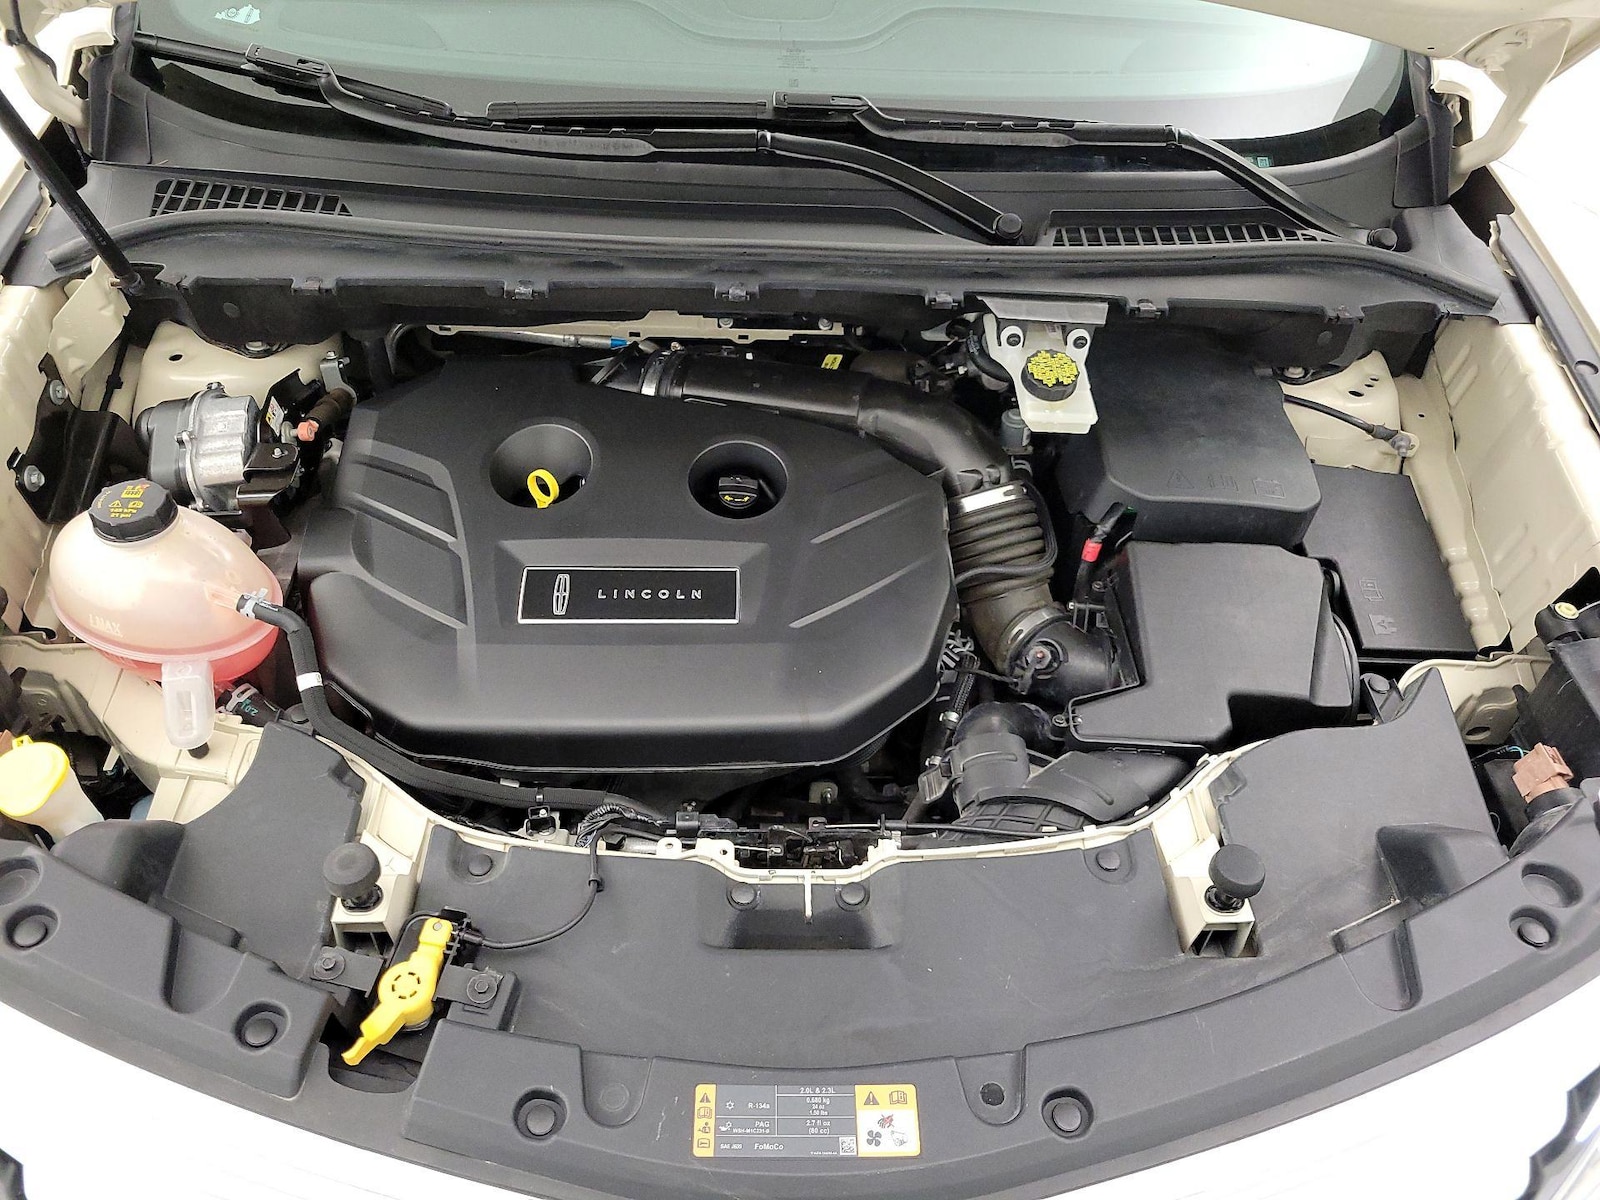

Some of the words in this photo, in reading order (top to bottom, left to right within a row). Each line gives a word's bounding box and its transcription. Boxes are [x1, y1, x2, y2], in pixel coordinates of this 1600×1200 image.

[597, 589, 702, 600] LINCOLN
[822, 1097, 831, 1105] kg
[808, 1127, 819, 1135] (80
